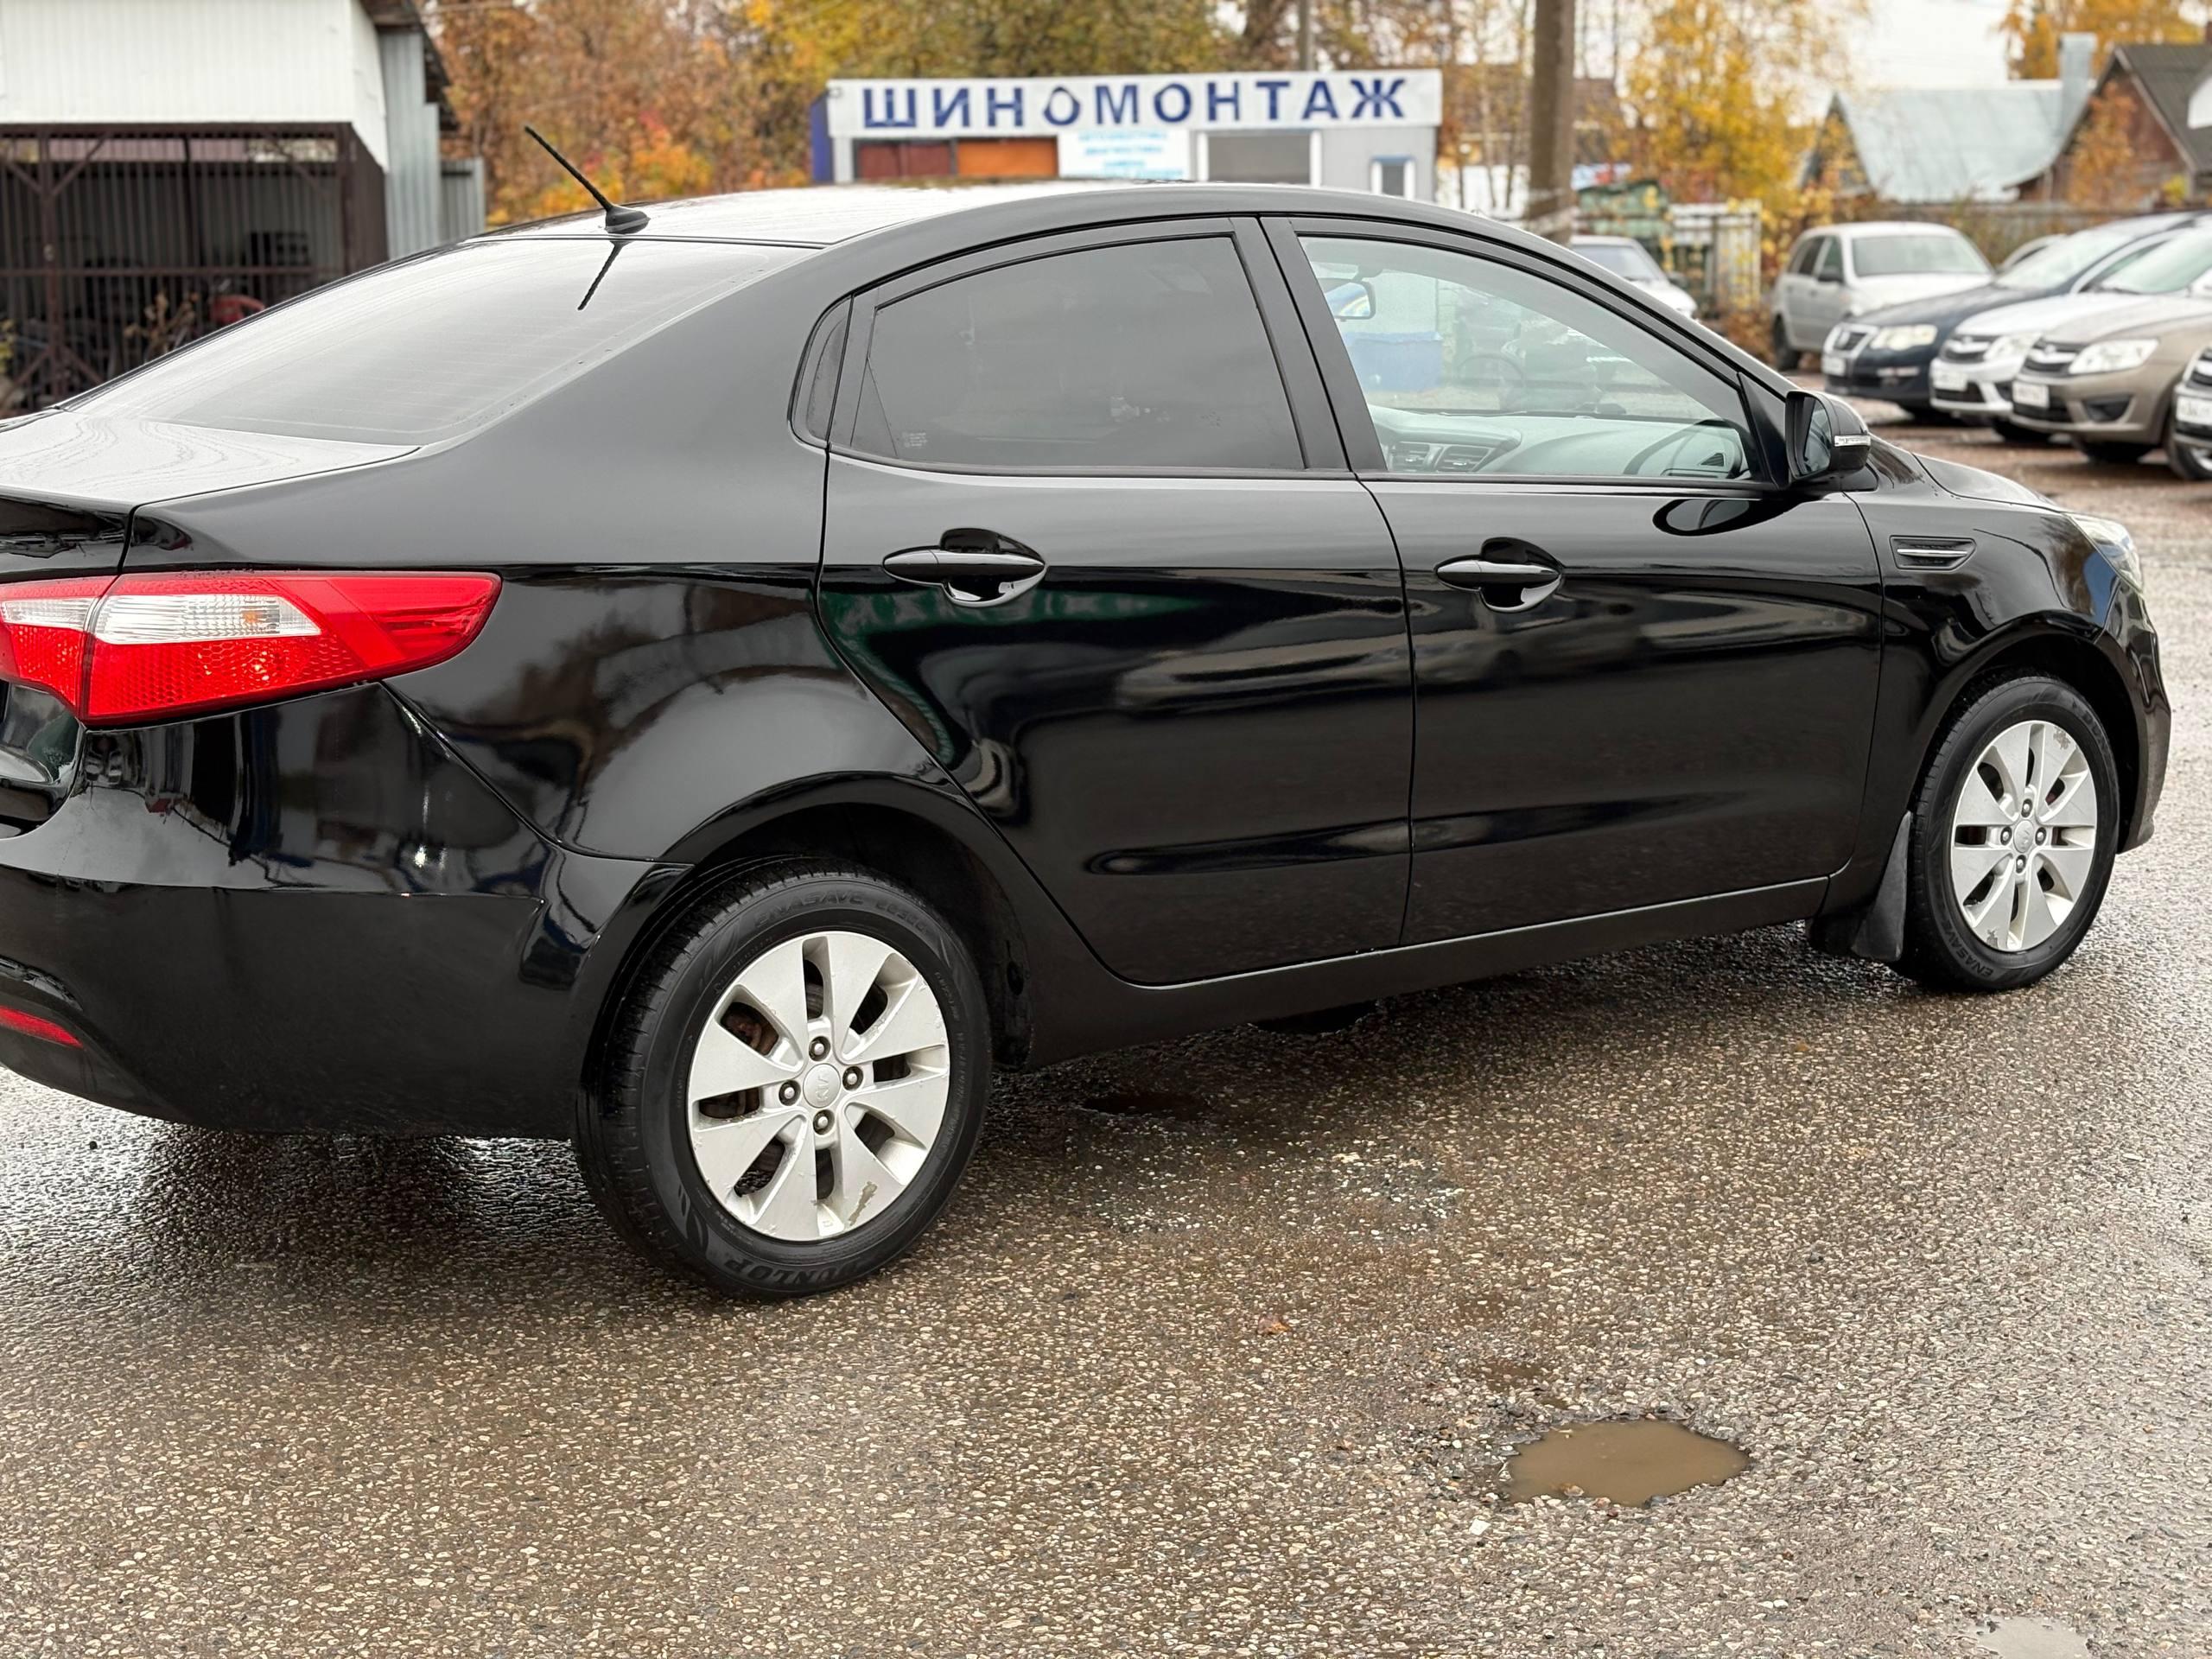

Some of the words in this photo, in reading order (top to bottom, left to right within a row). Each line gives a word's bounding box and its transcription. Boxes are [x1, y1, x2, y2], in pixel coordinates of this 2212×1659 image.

[863, 79, 1406, 129] ШИНОМОНТАЖ
[755, 889, 865, 928] ENASAVE
[1940, 918, 1995, 978] ENASAVE
[723, 1255, 861, 1286] DUNLOP
